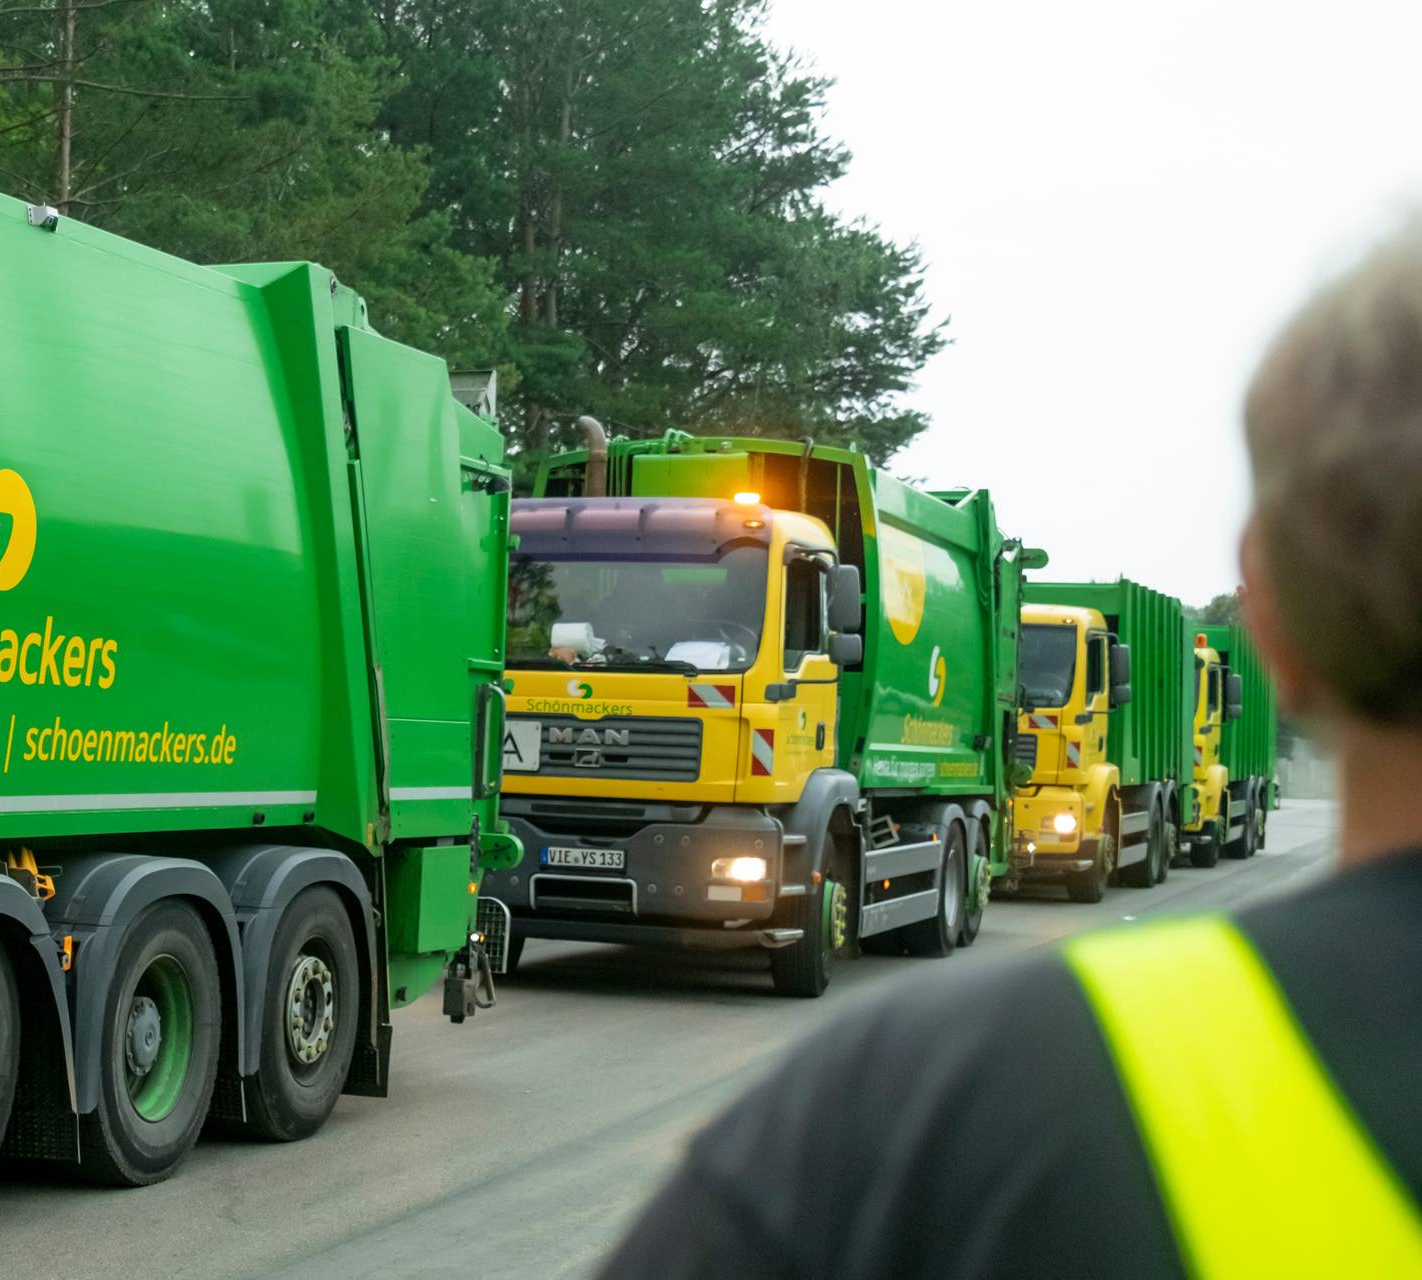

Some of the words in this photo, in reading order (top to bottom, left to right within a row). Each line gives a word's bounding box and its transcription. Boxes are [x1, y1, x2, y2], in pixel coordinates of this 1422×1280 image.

[23, 716, 236, 765] schoenmackers.de
[549, 727, 629, 745] MAN
[549, 850, 571, 864] VIE
[600, 852, 622, 866] 133
